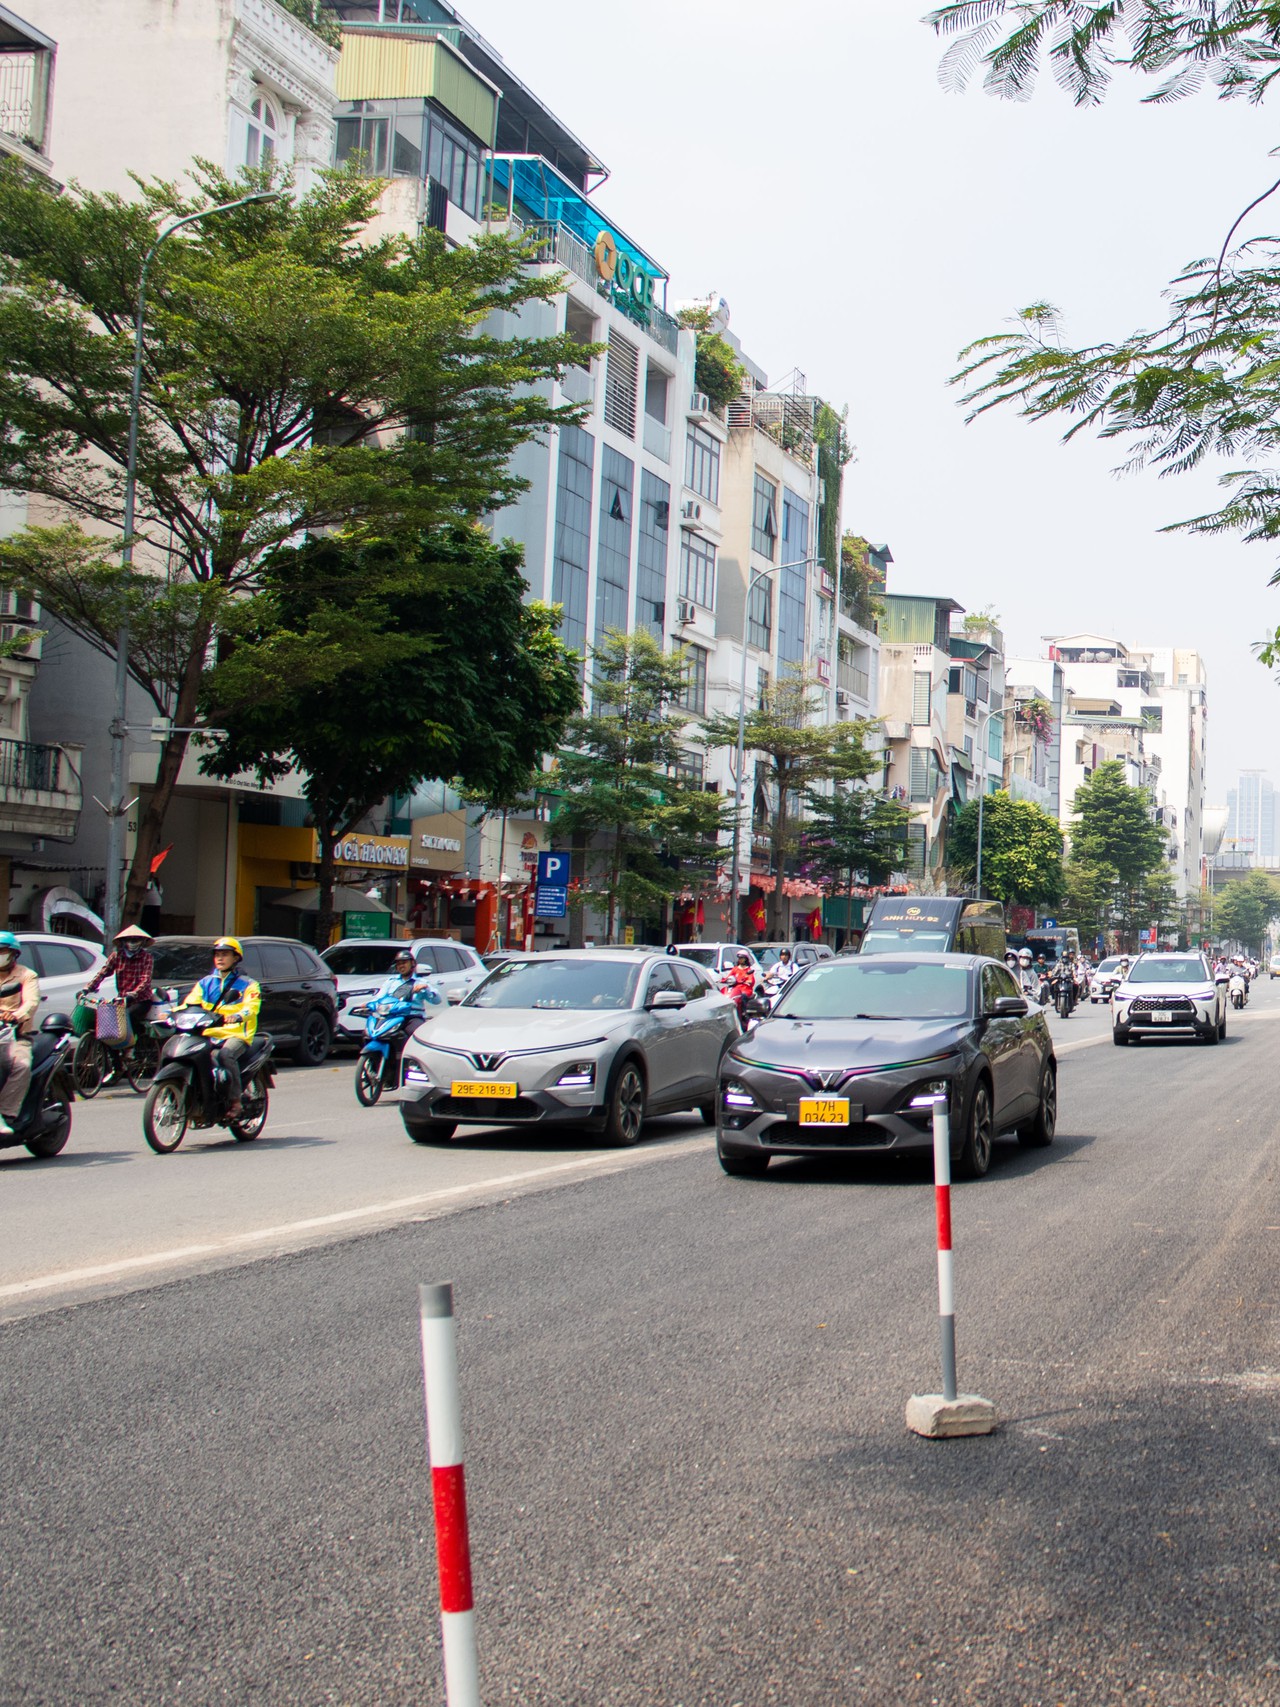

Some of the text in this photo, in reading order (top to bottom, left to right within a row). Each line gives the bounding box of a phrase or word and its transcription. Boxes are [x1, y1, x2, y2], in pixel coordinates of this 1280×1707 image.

[616, 251, 656, 311] OCB
[127, 820, 138, 832] 53
[385, 846, 408, 866] NAM
[546, 857, 562, 879] P
[457, 1084, 511, 1095] 29E-218.93
[815, 1101, 835, 1111] 17H
[804, 1112, 844, 1123] 034.23
